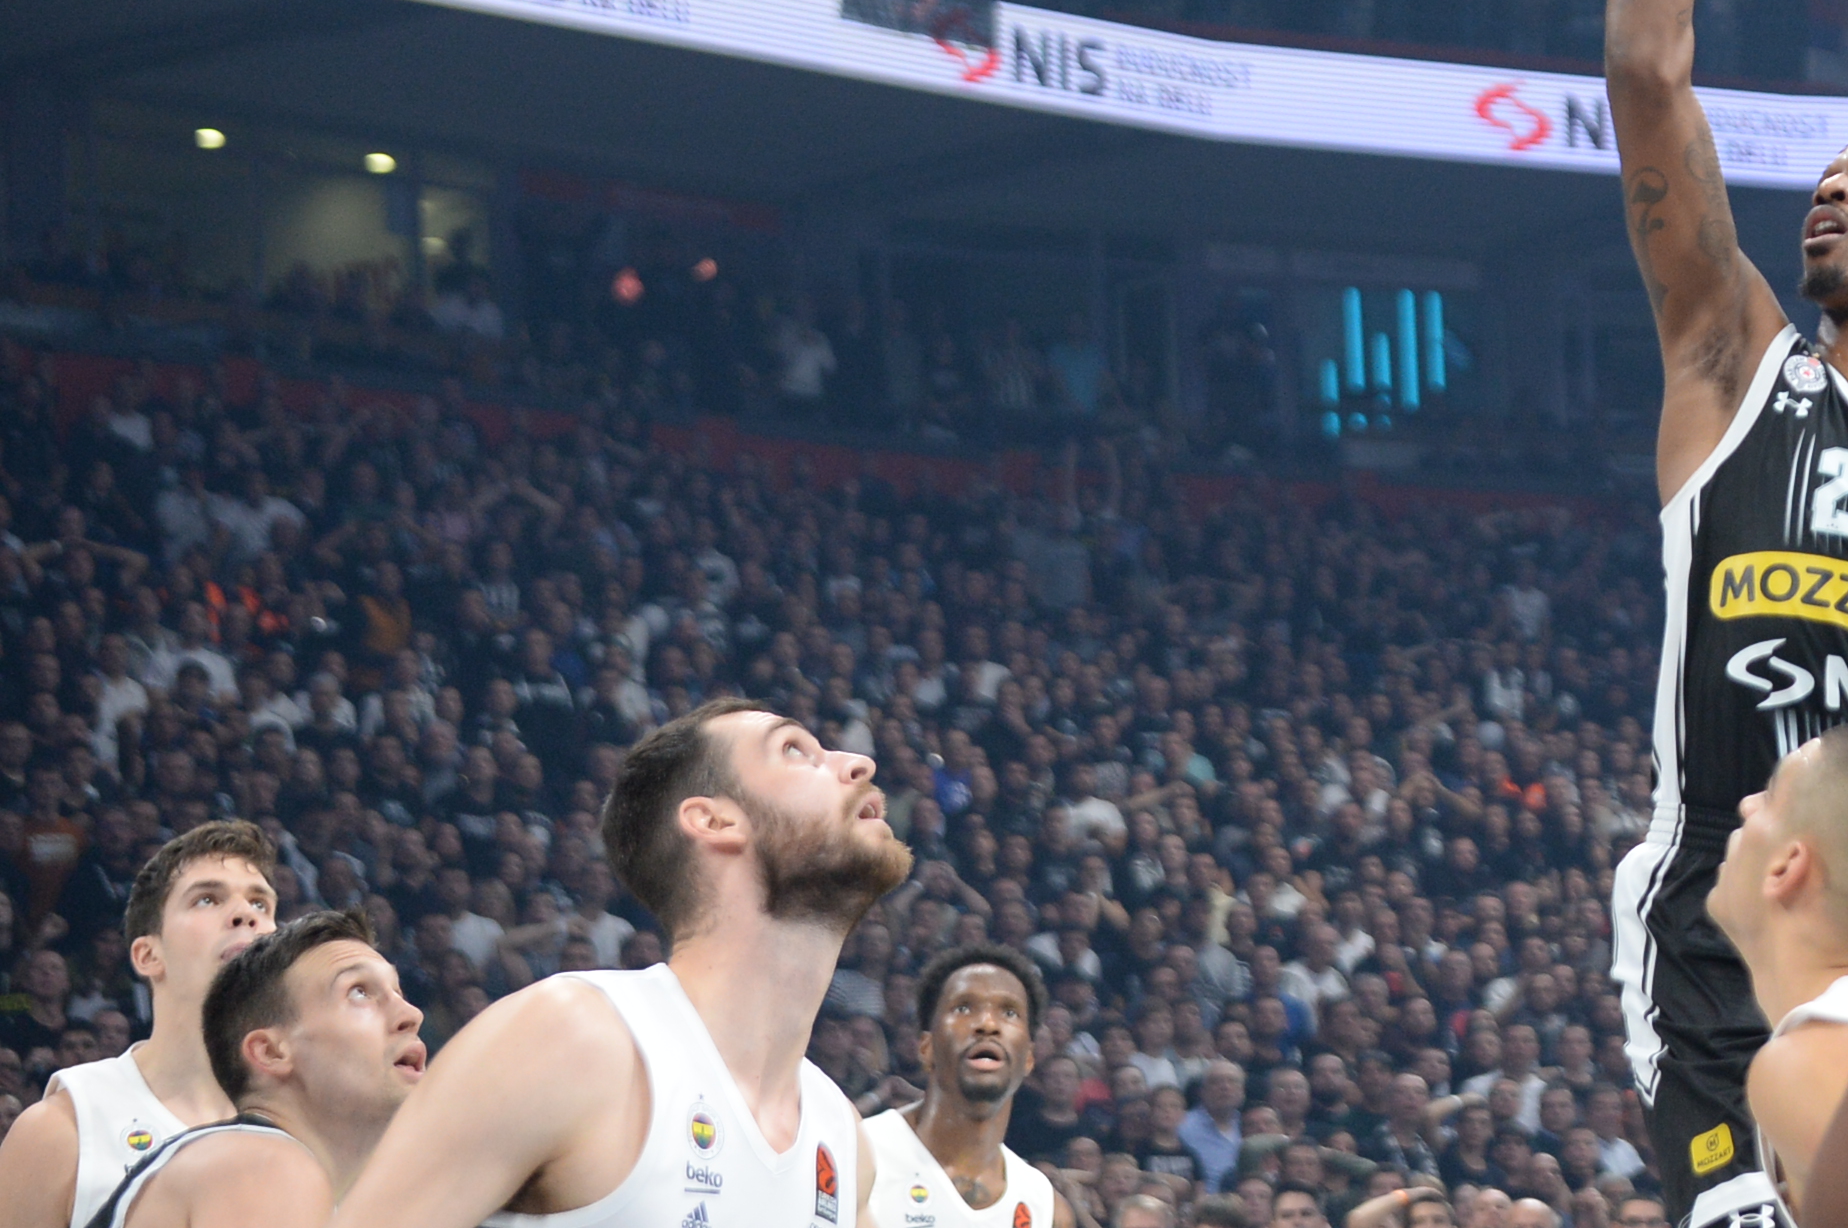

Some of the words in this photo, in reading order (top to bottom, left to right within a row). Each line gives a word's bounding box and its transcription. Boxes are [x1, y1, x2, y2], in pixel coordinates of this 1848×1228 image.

[1014, 22, 1107, 97] NIS
[1697, 1146, 1731, 1168] MOZZART
[685, 1160, 723, 1188] beko
[905, 1213, 935, 1223] beko
